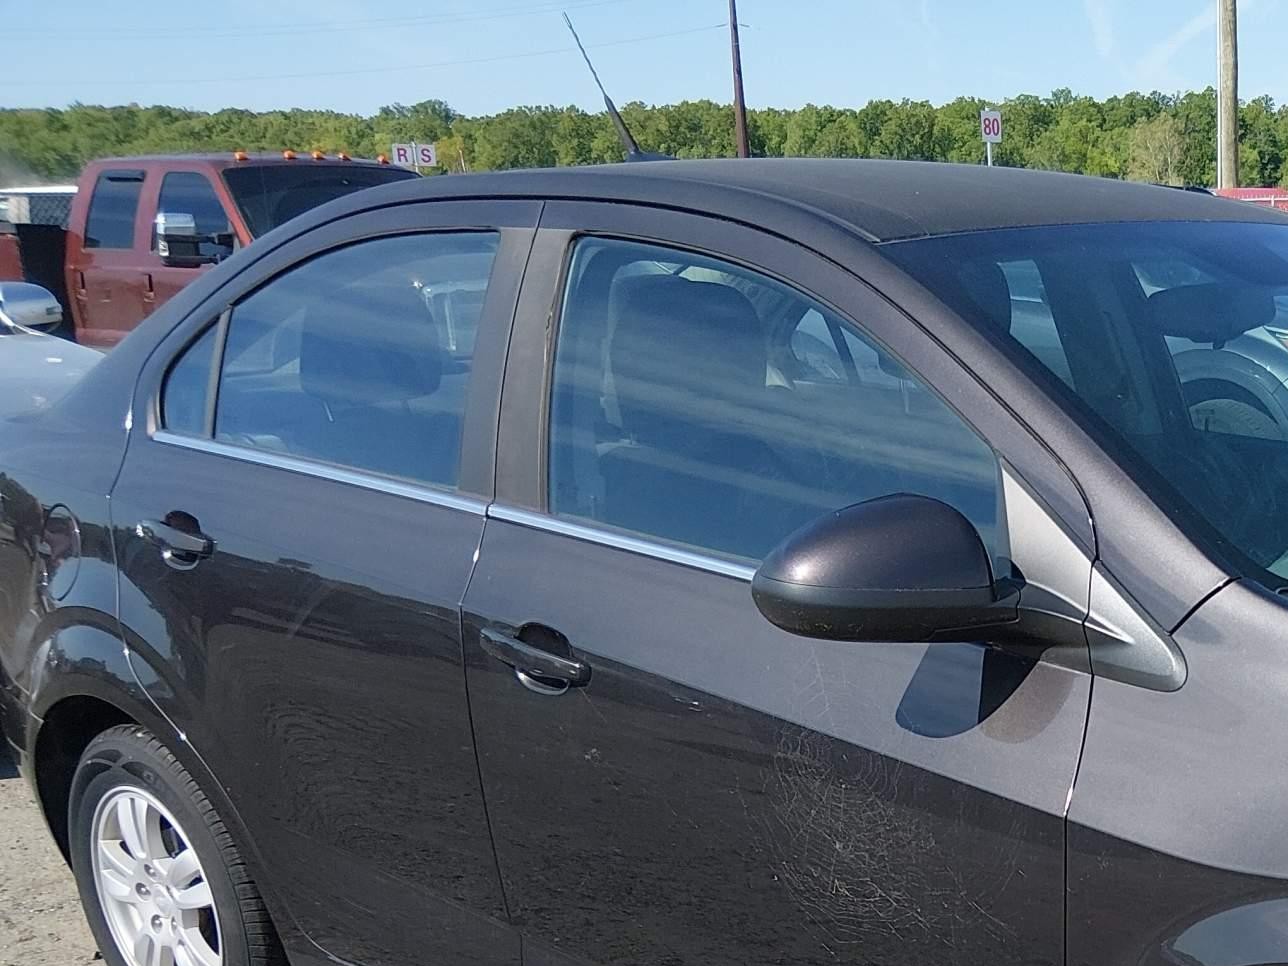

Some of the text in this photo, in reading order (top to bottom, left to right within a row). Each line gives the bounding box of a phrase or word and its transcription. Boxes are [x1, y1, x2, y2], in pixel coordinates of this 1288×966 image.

[983, 117, 1000, 136] 80
[397, 148, 408, 162] R
[420, 148, 432, 163] S
